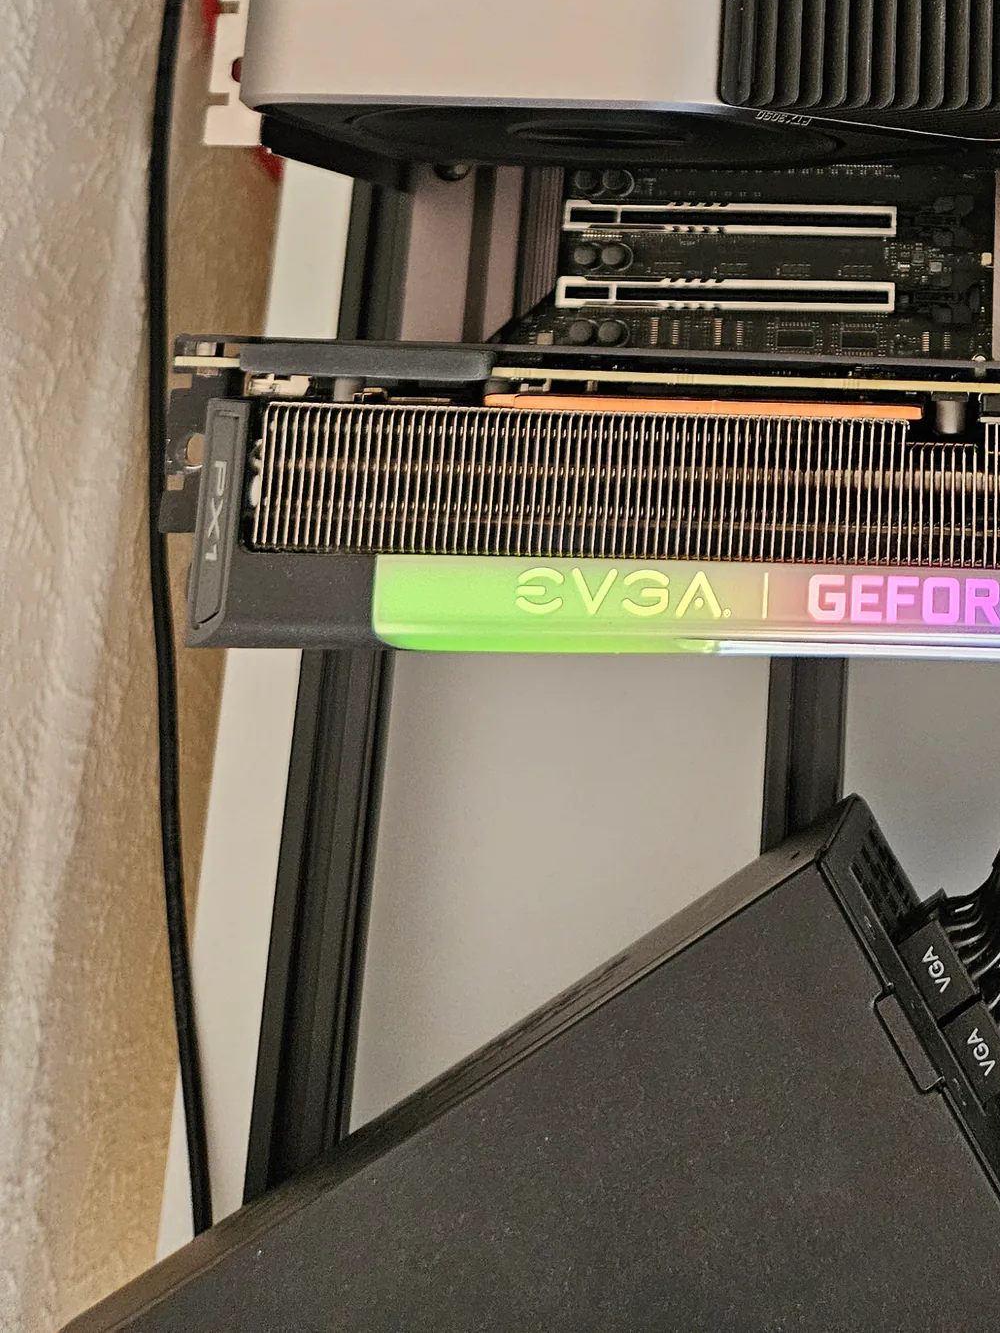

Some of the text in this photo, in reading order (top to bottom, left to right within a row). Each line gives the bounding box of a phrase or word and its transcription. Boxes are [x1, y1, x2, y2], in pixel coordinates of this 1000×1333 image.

[205, 460, 227, 561] PX1
[922, 945, 951, 994] VGA
[967, 1027, 996, 1077] VGA
